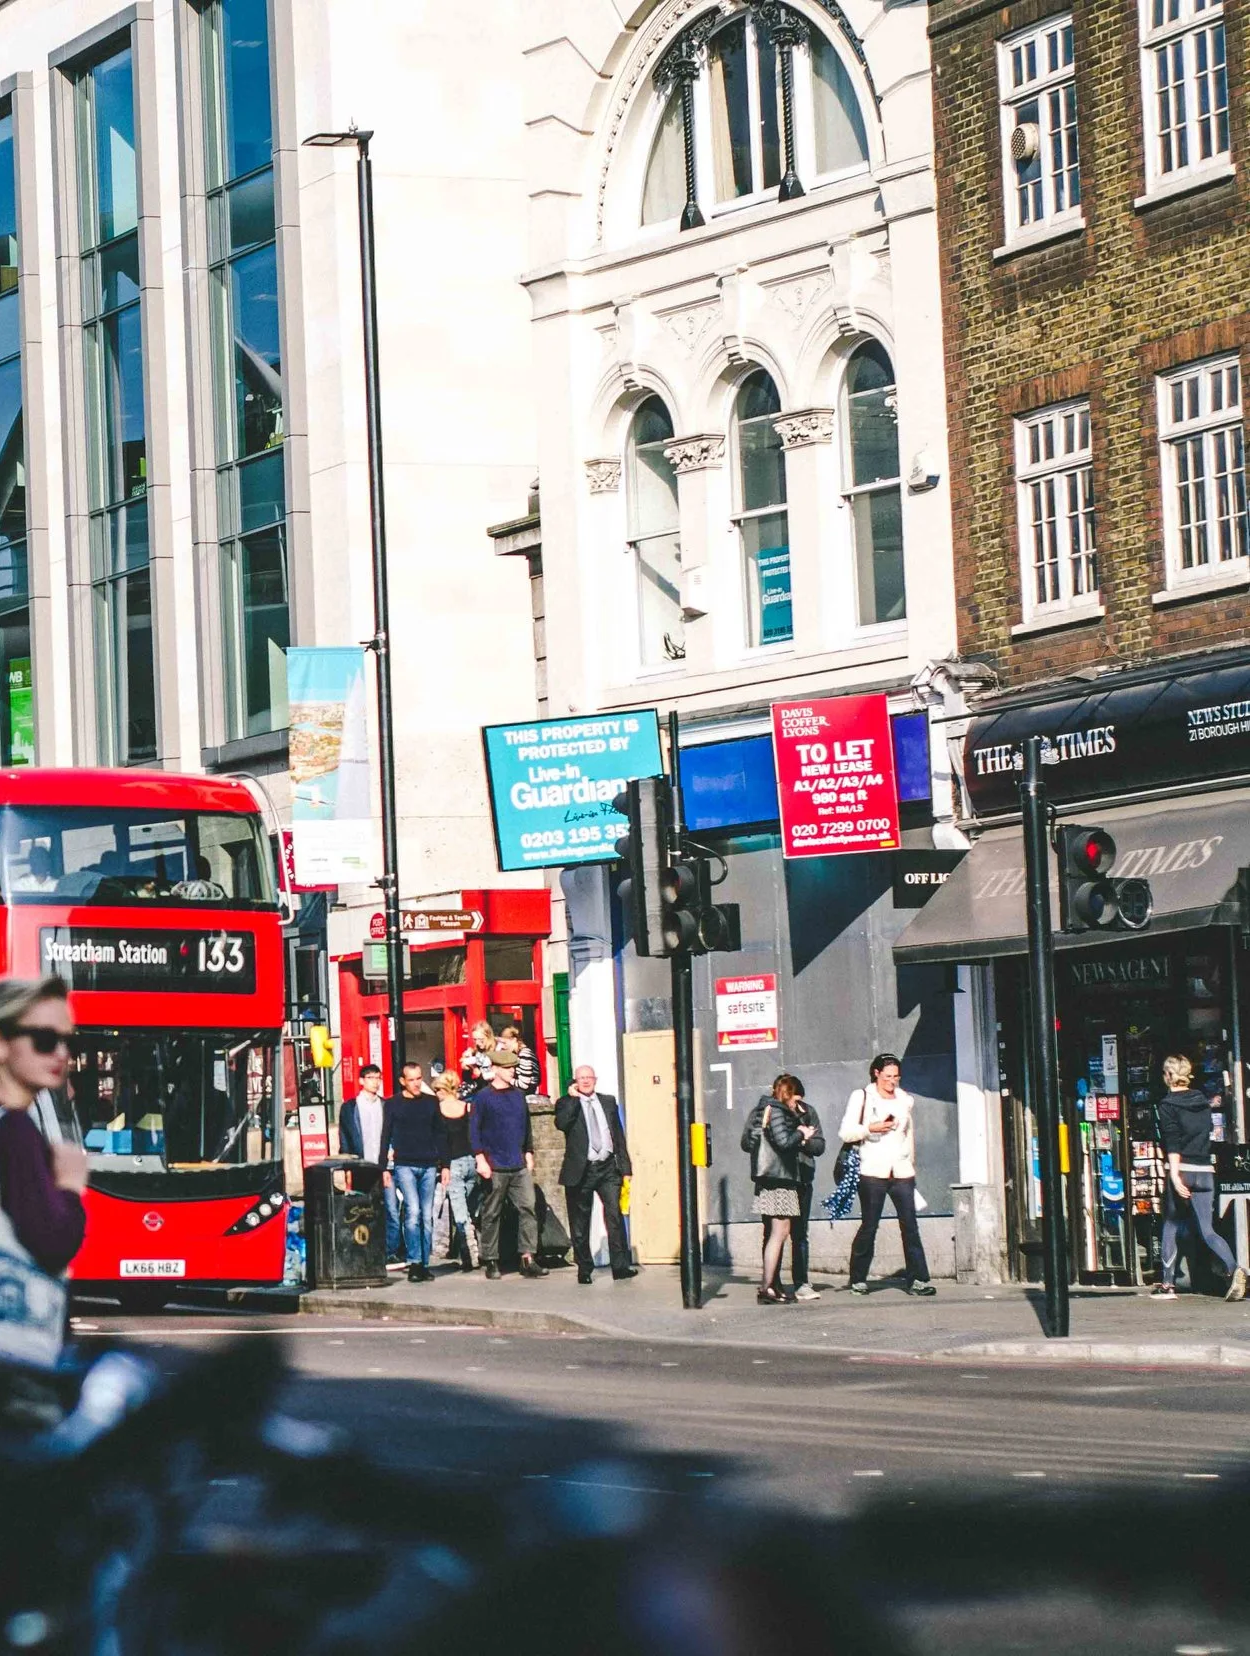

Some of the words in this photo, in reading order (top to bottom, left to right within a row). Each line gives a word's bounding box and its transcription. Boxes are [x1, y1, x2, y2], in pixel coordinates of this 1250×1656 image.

[781, 708, 813, 719] DAVIS
[782, 716, 830, 728] COFFER
[1187, 705, 1221, 726] NEWS
[503, 728, 539, 746] THIS
[541, 720, 621, 741] PROPERTY
[623, 718, 640, 733] IS
[783, 726, 819, 738] LYONS
[1188, 729, 1198, 741] 21
[1198, 722, 1240, 740] BOROUGH
[518, 739, 607, 761] PROTECTED
[609, 736, 630, 751] BY
[795, 743, 827, 764] TO
[833, 739, 874, 761] LET
[974, 744, 1013, 775] THE
[1056, 725, 1117, 761] TIMES
[528, 763, 581, 784] Live-in
[801, 764, 830, 777] NEW
[833, 760, 872, 774] LEASE
[510, 775, 639, 810] Guardian
[793, 774, 884, 793] A1/A2/A3/A4
[839, 794, 855, 804] sq
[856, 789, 868, 801] ft
[791, 823, 818, 837] 020
[820, 820, 854, 835] 7299
[856, 817, 890, 832] 0700
[520, 829, 565, 849] 0203
[568, 825, 602, 844] 195
[1108, 836, 1224, 879] TIMES
[904, 873, 928, 885] OFF
[371, 926, 386, 935] OFFICE
[372, 918, 384, 927] POST
[45, 937, 115, 963] Streatham
[118, 939, 167, 965] Station
[199, 936, 244, 972] 133
[725, 979, 765, 994] WARNING
[727, 1000, 766, 1014] safesite
[125, 1262, 155, 1274] LK66
[157, 1262, 179, 1274] HBZ
